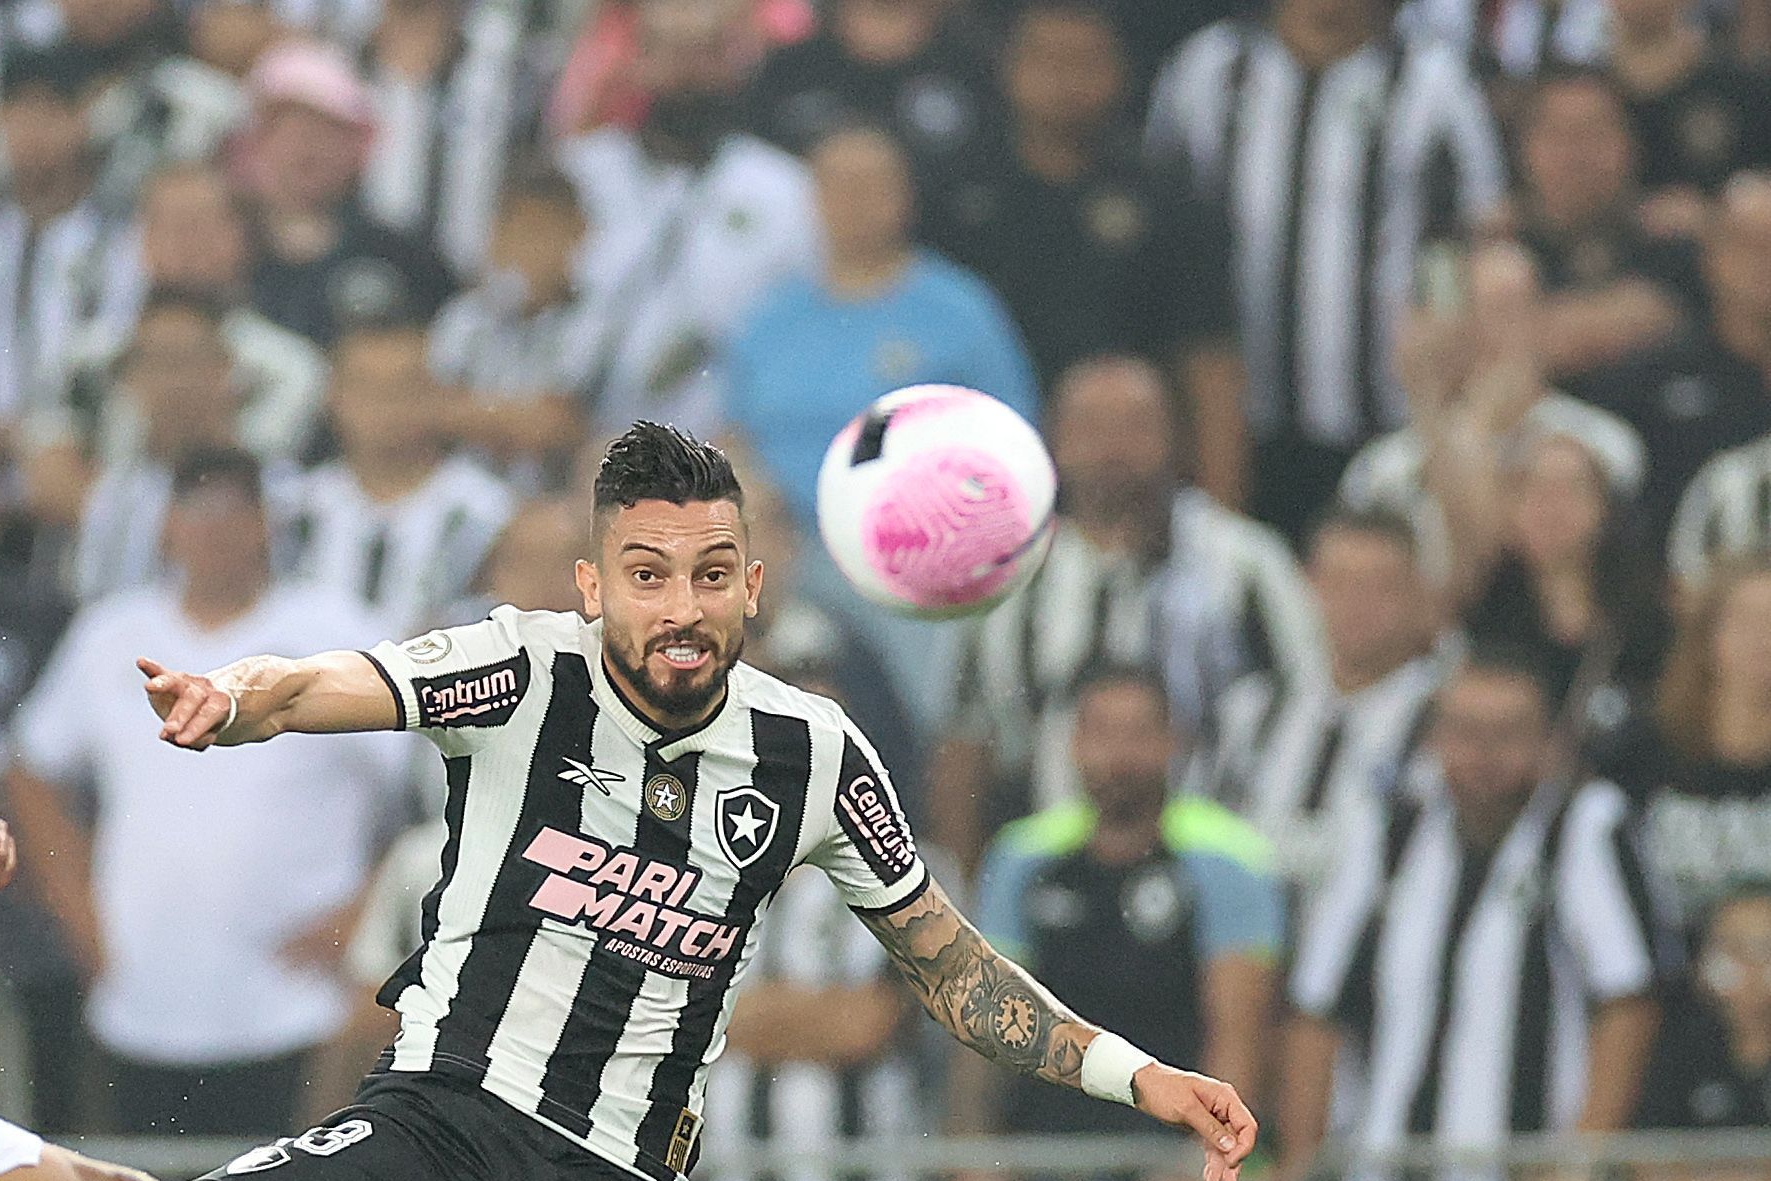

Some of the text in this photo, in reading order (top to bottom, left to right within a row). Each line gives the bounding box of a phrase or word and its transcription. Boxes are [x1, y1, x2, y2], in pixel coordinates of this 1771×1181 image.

[849, 775, 914, 866] Centrum
[522, 826, 697, 908] PARI
[529, 872, 740, 961] MATCH
[605, 938, 715, 980] APOSTAS ESPORTIVAS
